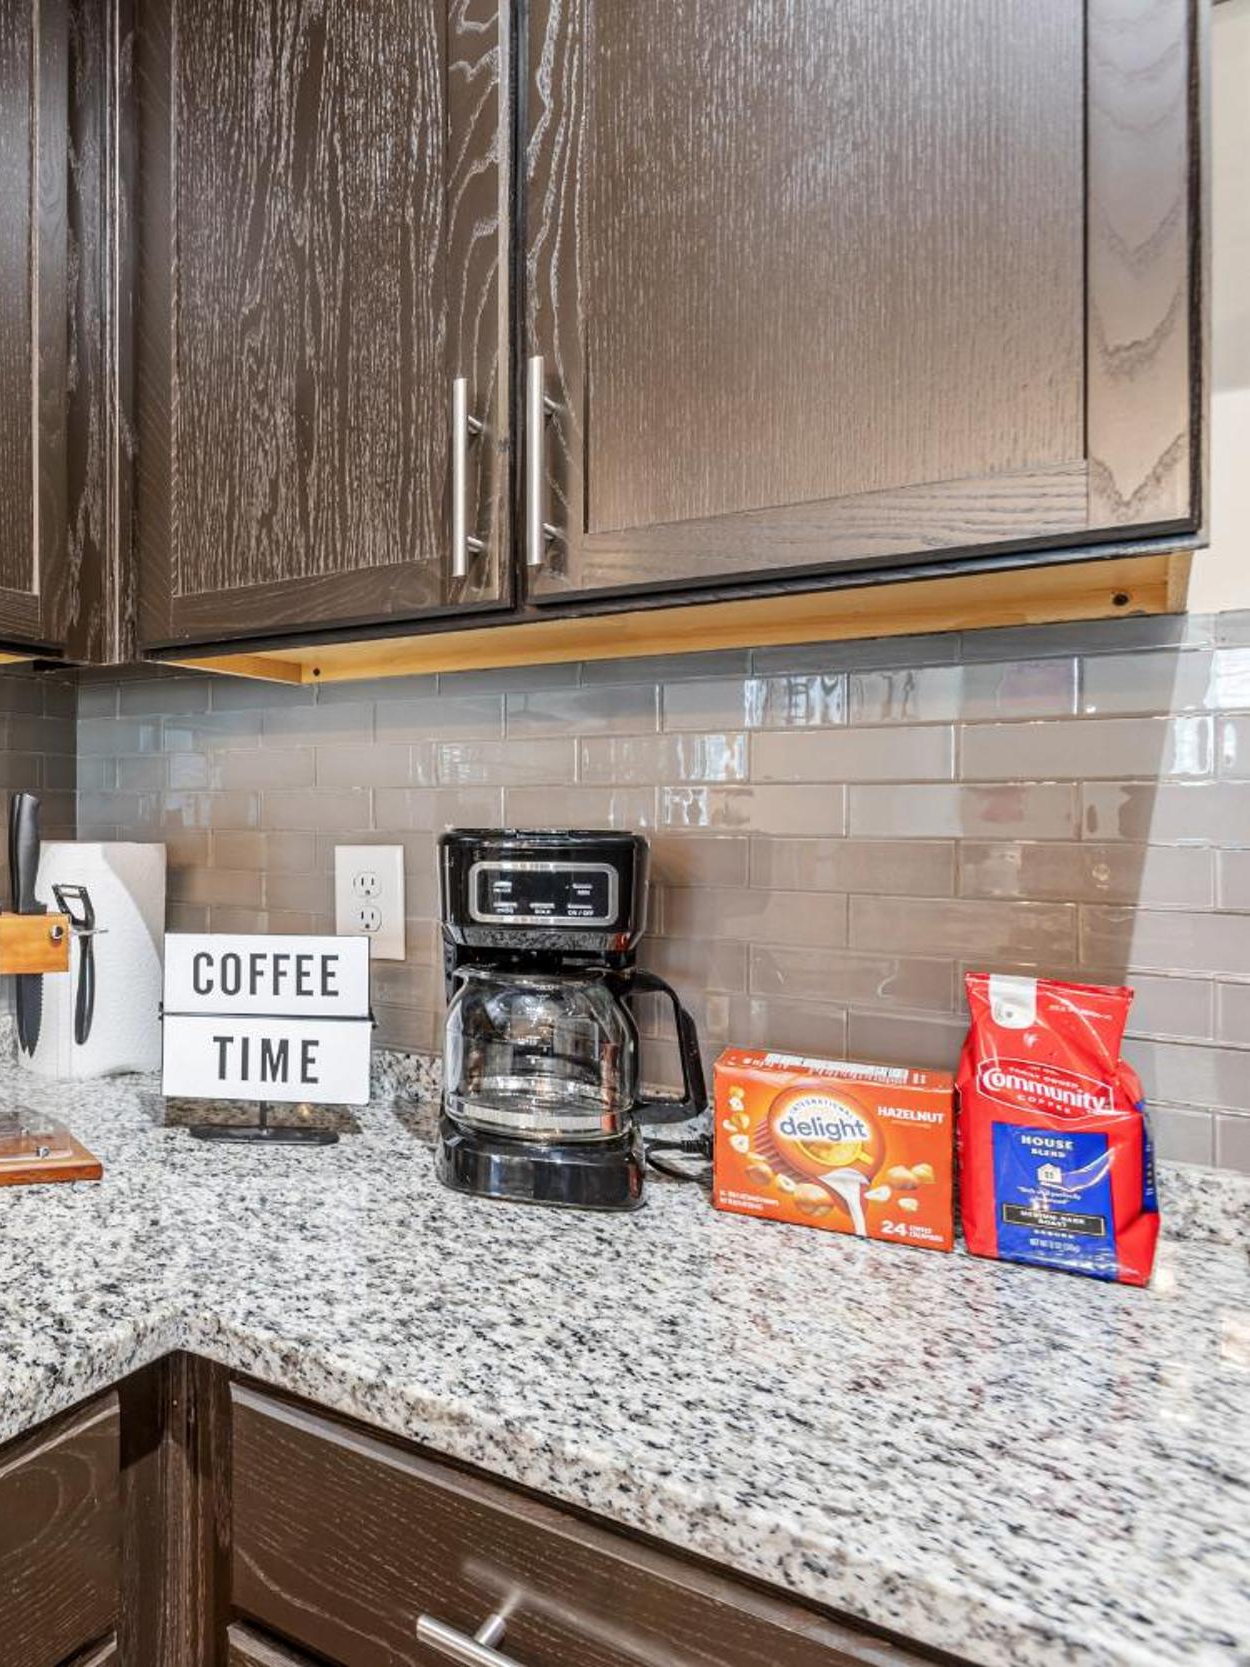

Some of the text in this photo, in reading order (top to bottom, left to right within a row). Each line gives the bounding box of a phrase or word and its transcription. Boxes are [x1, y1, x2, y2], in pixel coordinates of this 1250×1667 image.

[192, 951, 339, 997] COFFEE
[213, 1036, 319, 1084] TIME
[983, 1067, 1106, 1114] Community
[1016, 1094, 1071, 1114] COFFEE
[878, 1106, 944, 1124] HAZELNUT
[780, 1116, 868, 1141] delight
[1021, 1134, 1074, 1151] HOUSE
[1031, 1148, 1066, 1158] BLEND
[881, 1220, 908, 1237] 24
